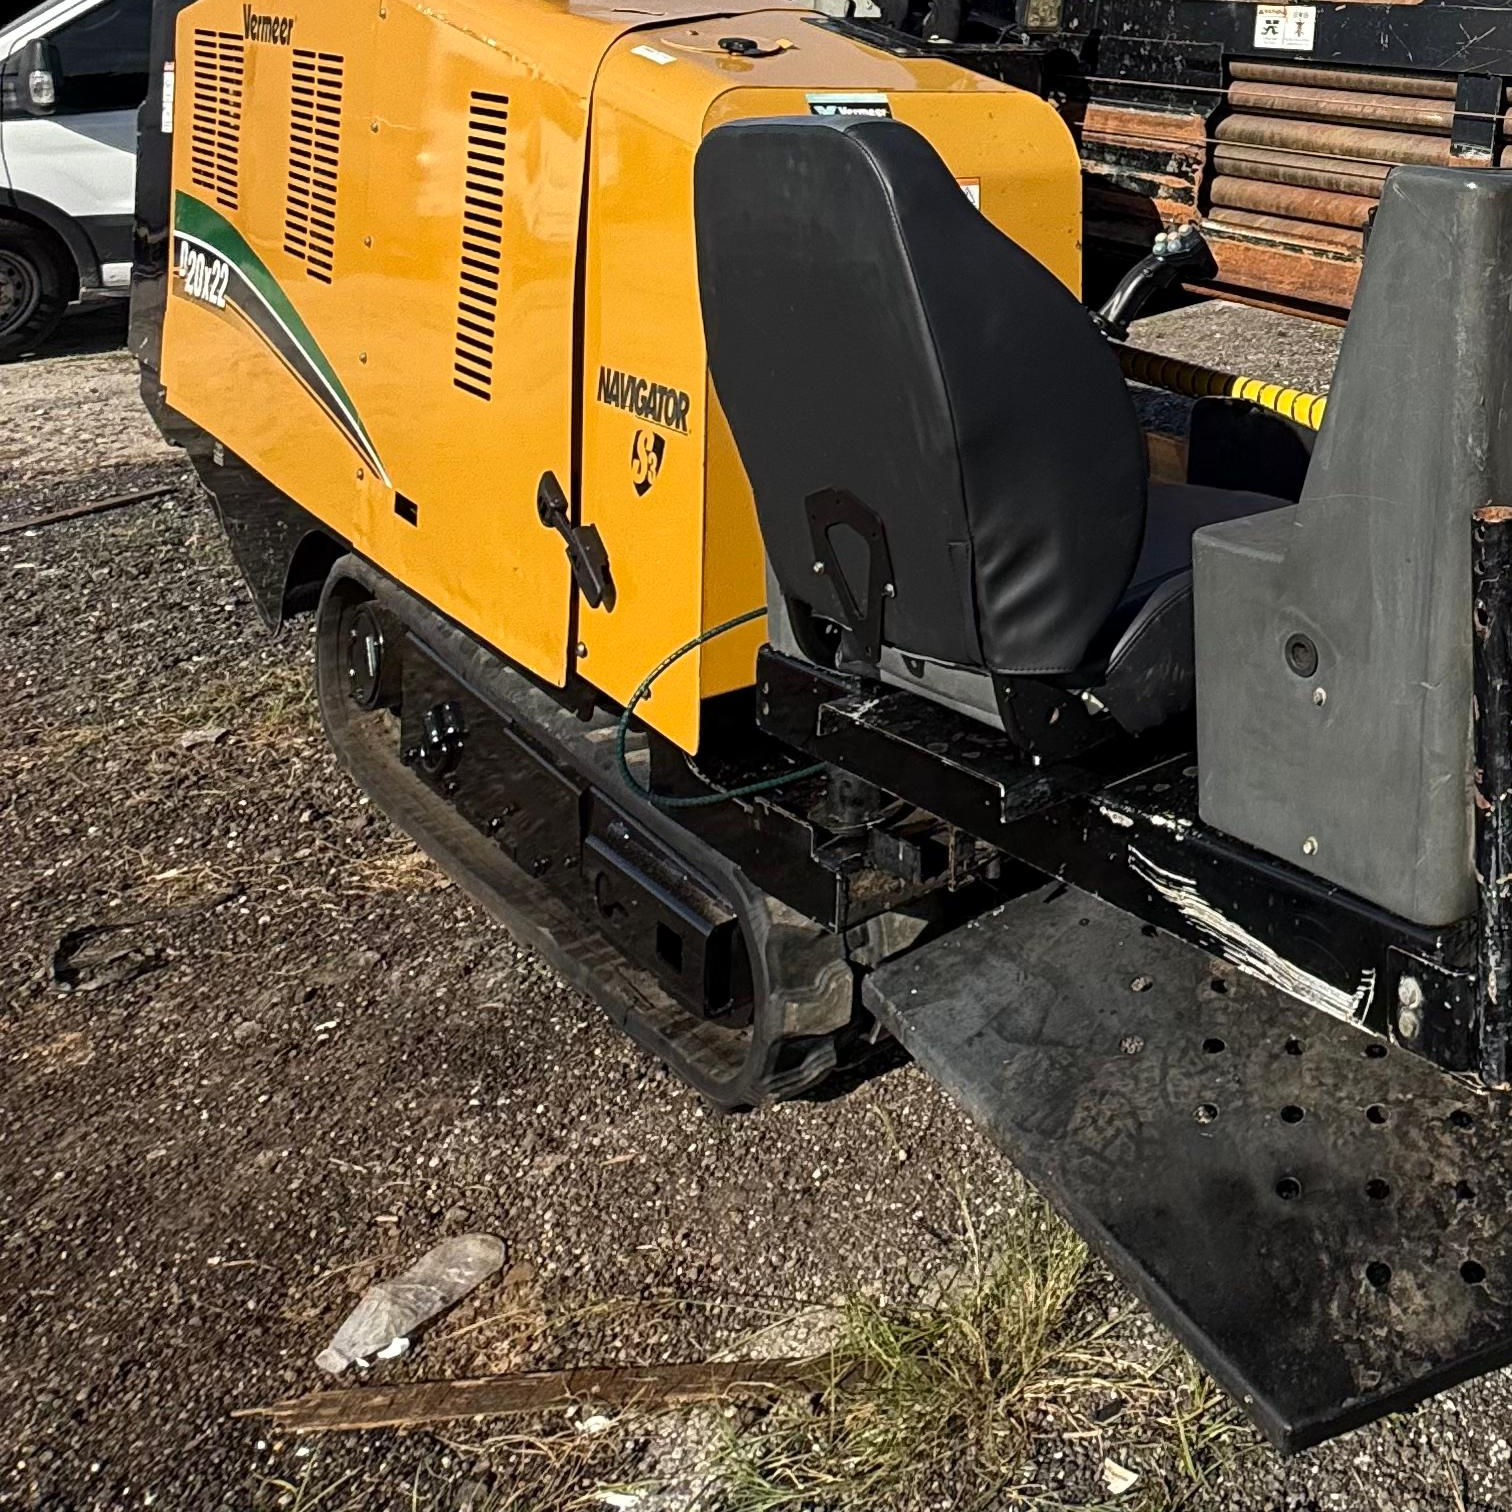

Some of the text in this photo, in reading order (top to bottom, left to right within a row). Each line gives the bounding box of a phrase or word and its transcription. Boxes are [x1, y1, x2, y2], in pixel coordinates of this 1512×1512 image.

[243, 3, 294, 46] Vermeer
[838, 106, 887, 117] Vermeer
[179, 240, 230, 308] D20x22
[597, 365, 690, 432] NAVIGATOR
